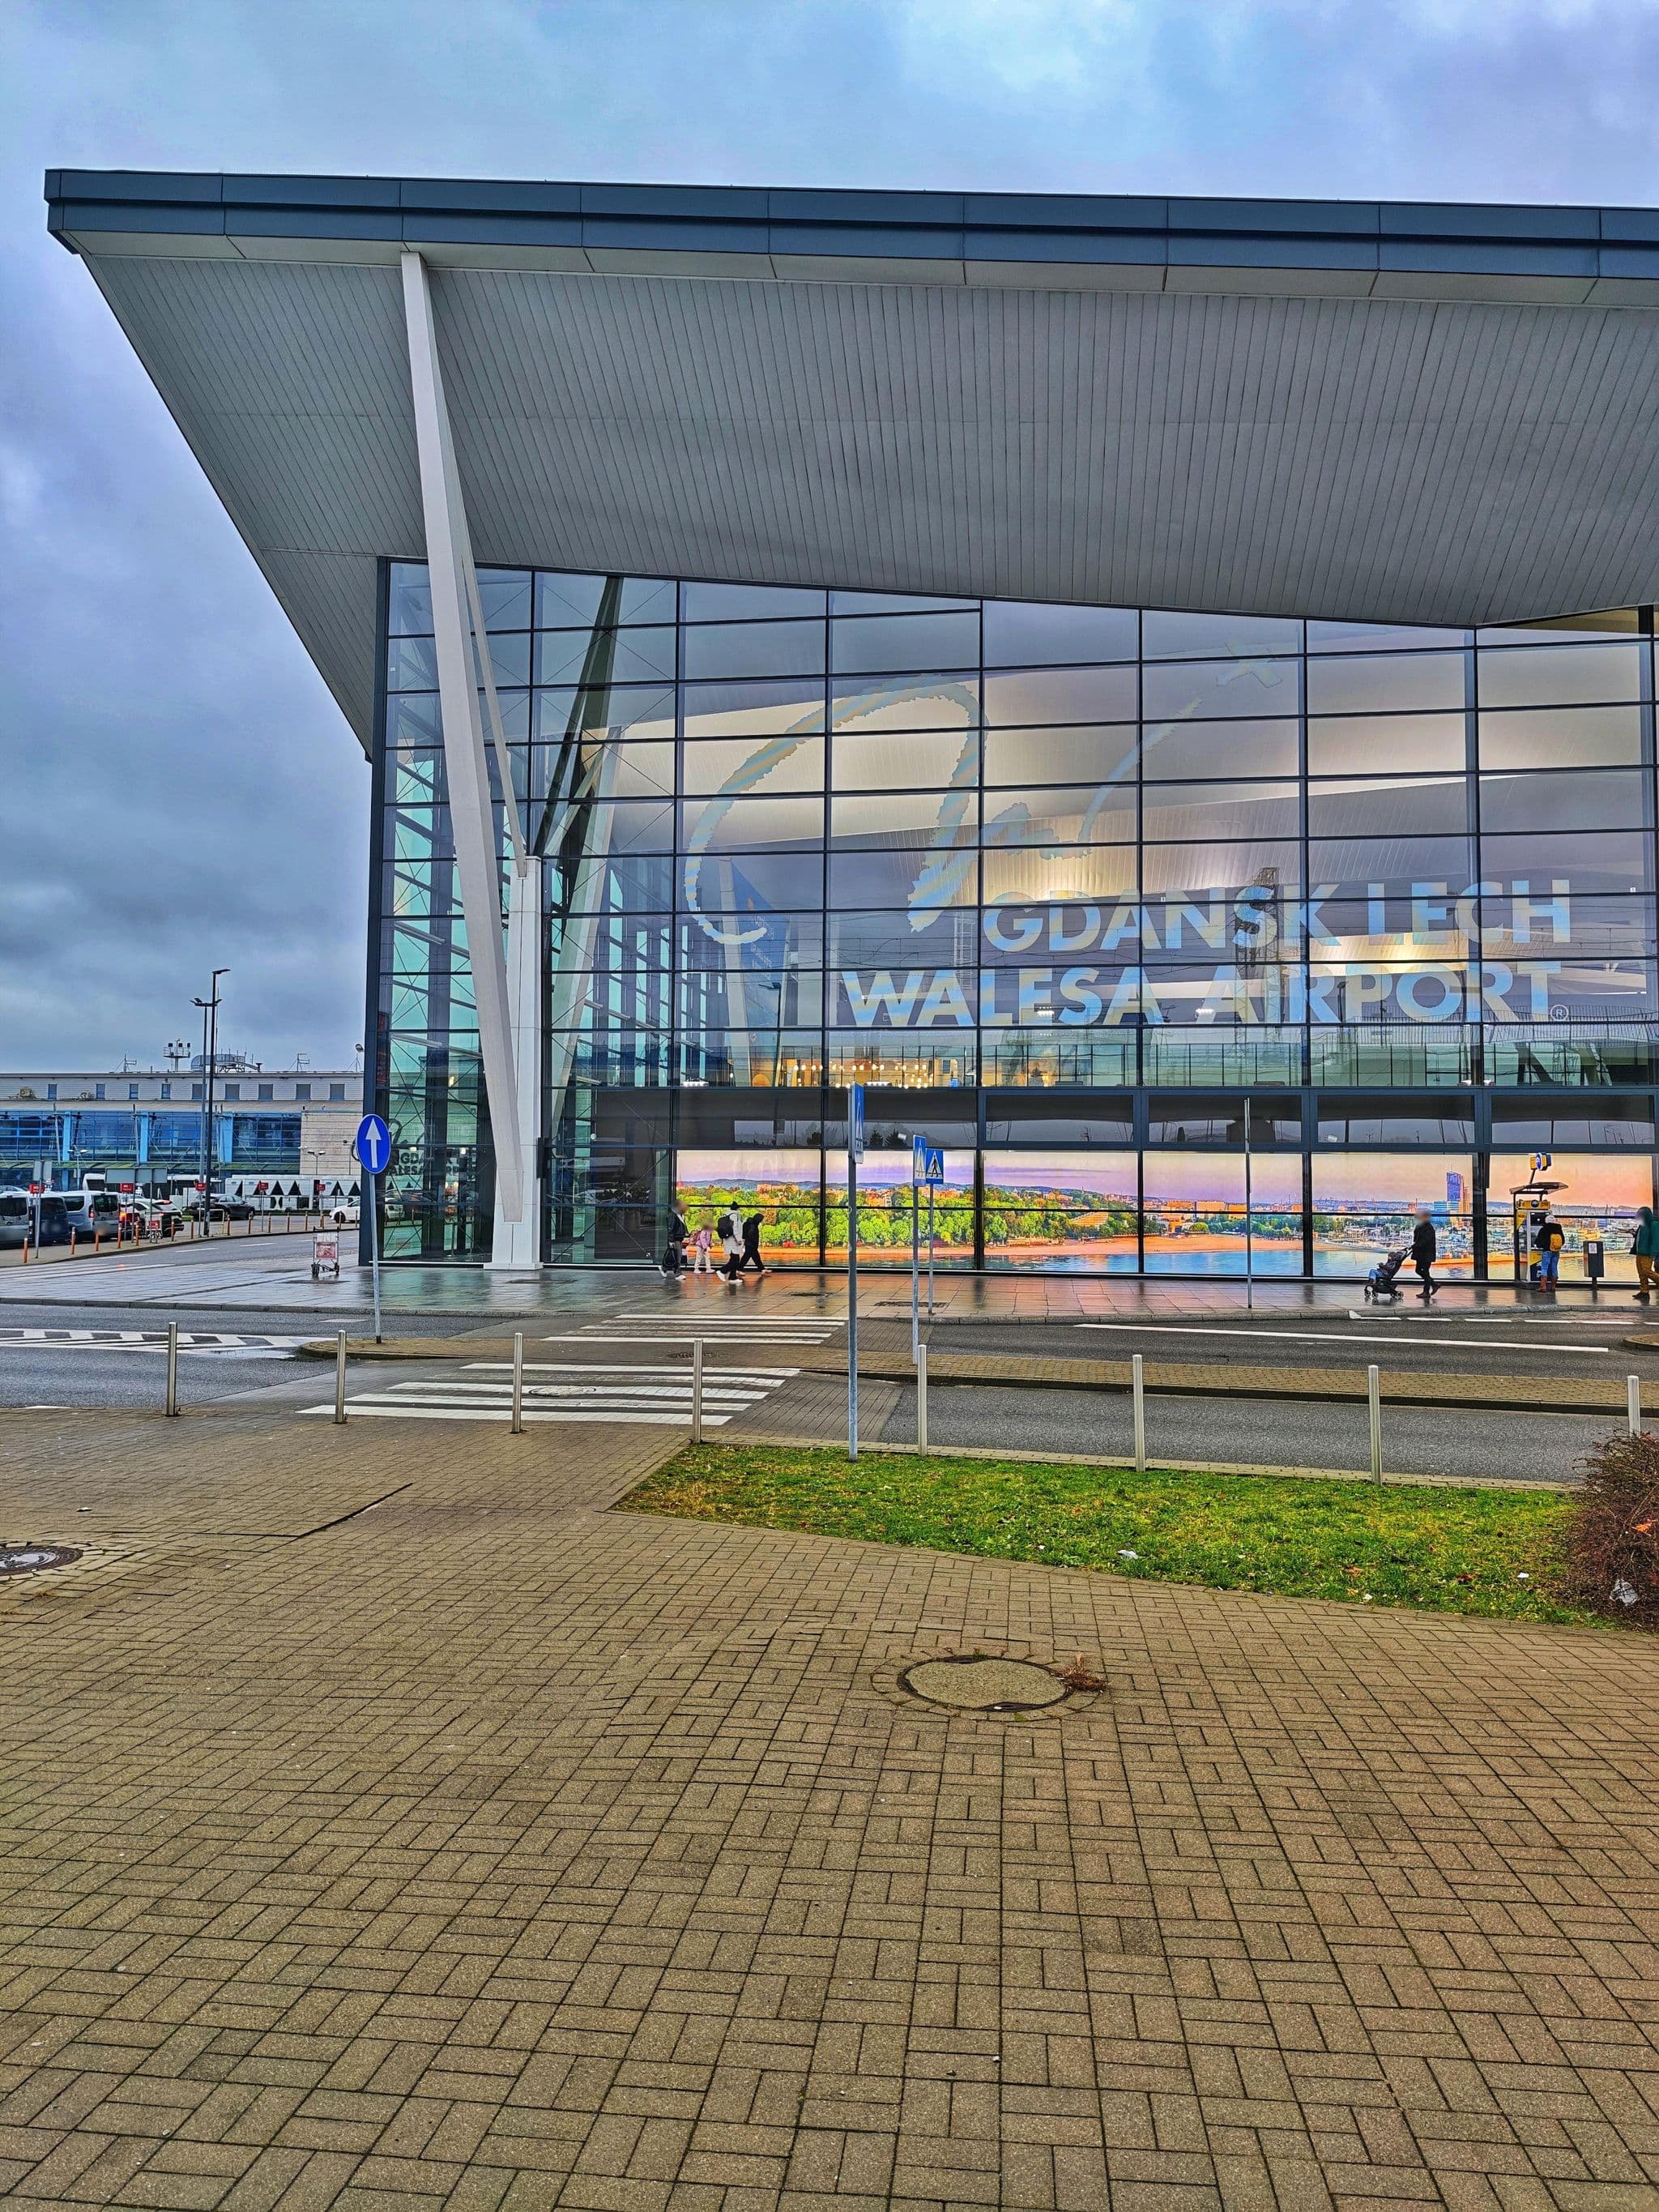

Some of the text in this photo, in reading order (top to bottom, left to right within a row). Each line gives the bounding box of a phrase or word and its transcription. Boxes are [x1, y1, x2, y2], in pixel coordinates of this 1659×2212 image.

[983, 879, 1571, 952] GDANSK LECH
[842, 967, 1166, 1027] WALESA
